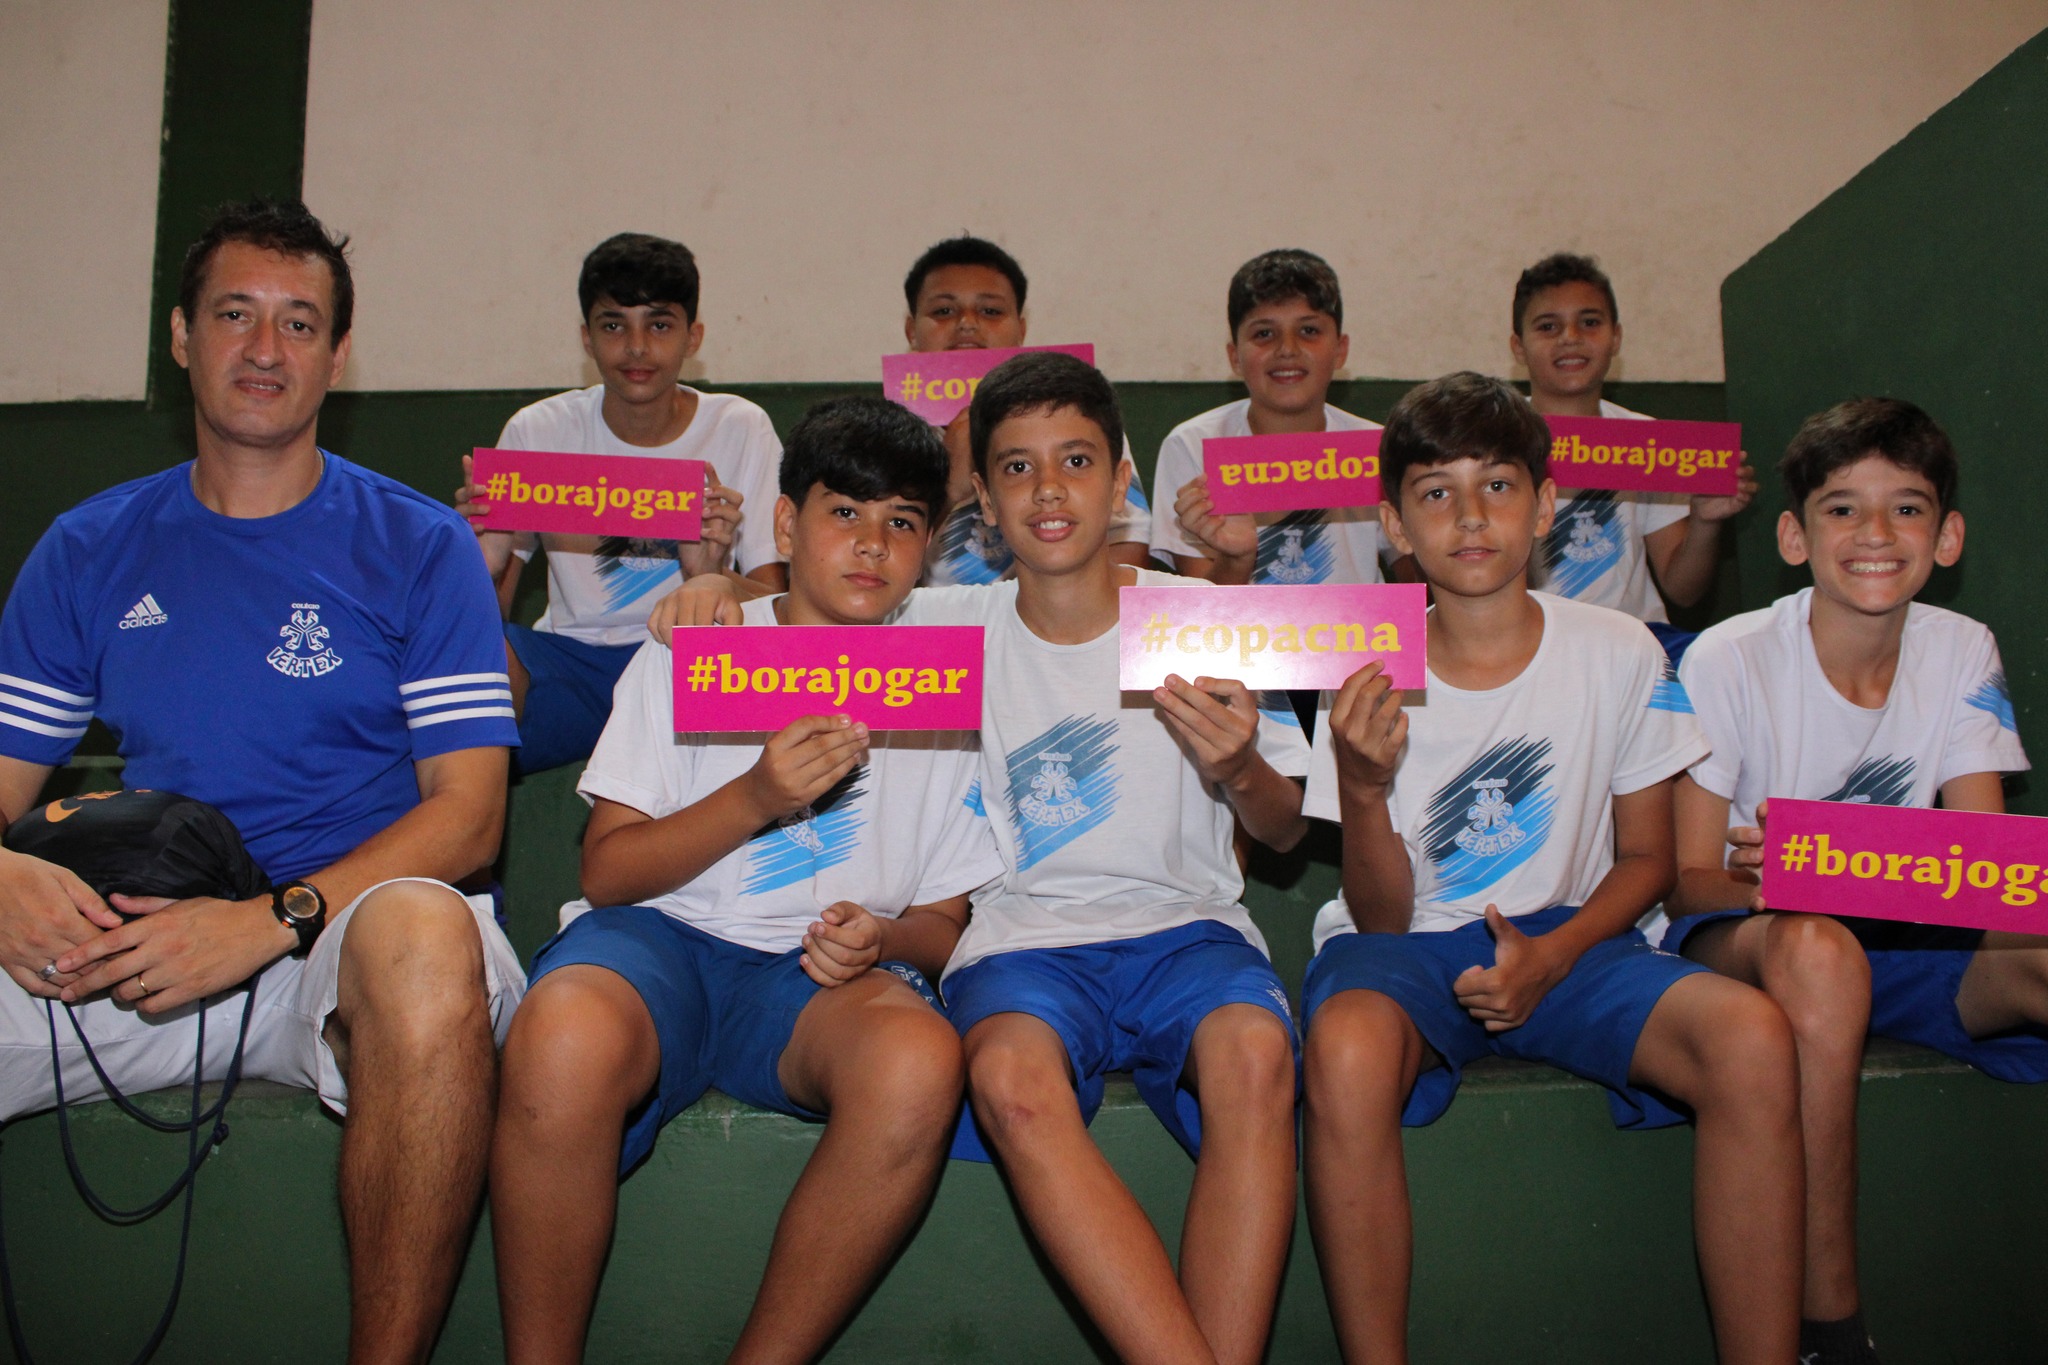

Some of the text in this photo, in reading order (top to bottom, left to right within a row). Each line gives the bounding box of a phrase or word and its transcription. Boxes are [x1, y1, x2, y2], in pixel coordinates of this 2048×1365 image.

[1551, 436, 1732, 476] #borajogar
[486, 472, 696, 519] #borajogar
[119, 613, 168, 630] adidas
[1142, 613, 1401, 668] #copacna
[688, 654, 968, 707] #borajogar
[1781, 834, 2048, 906] #borajog
